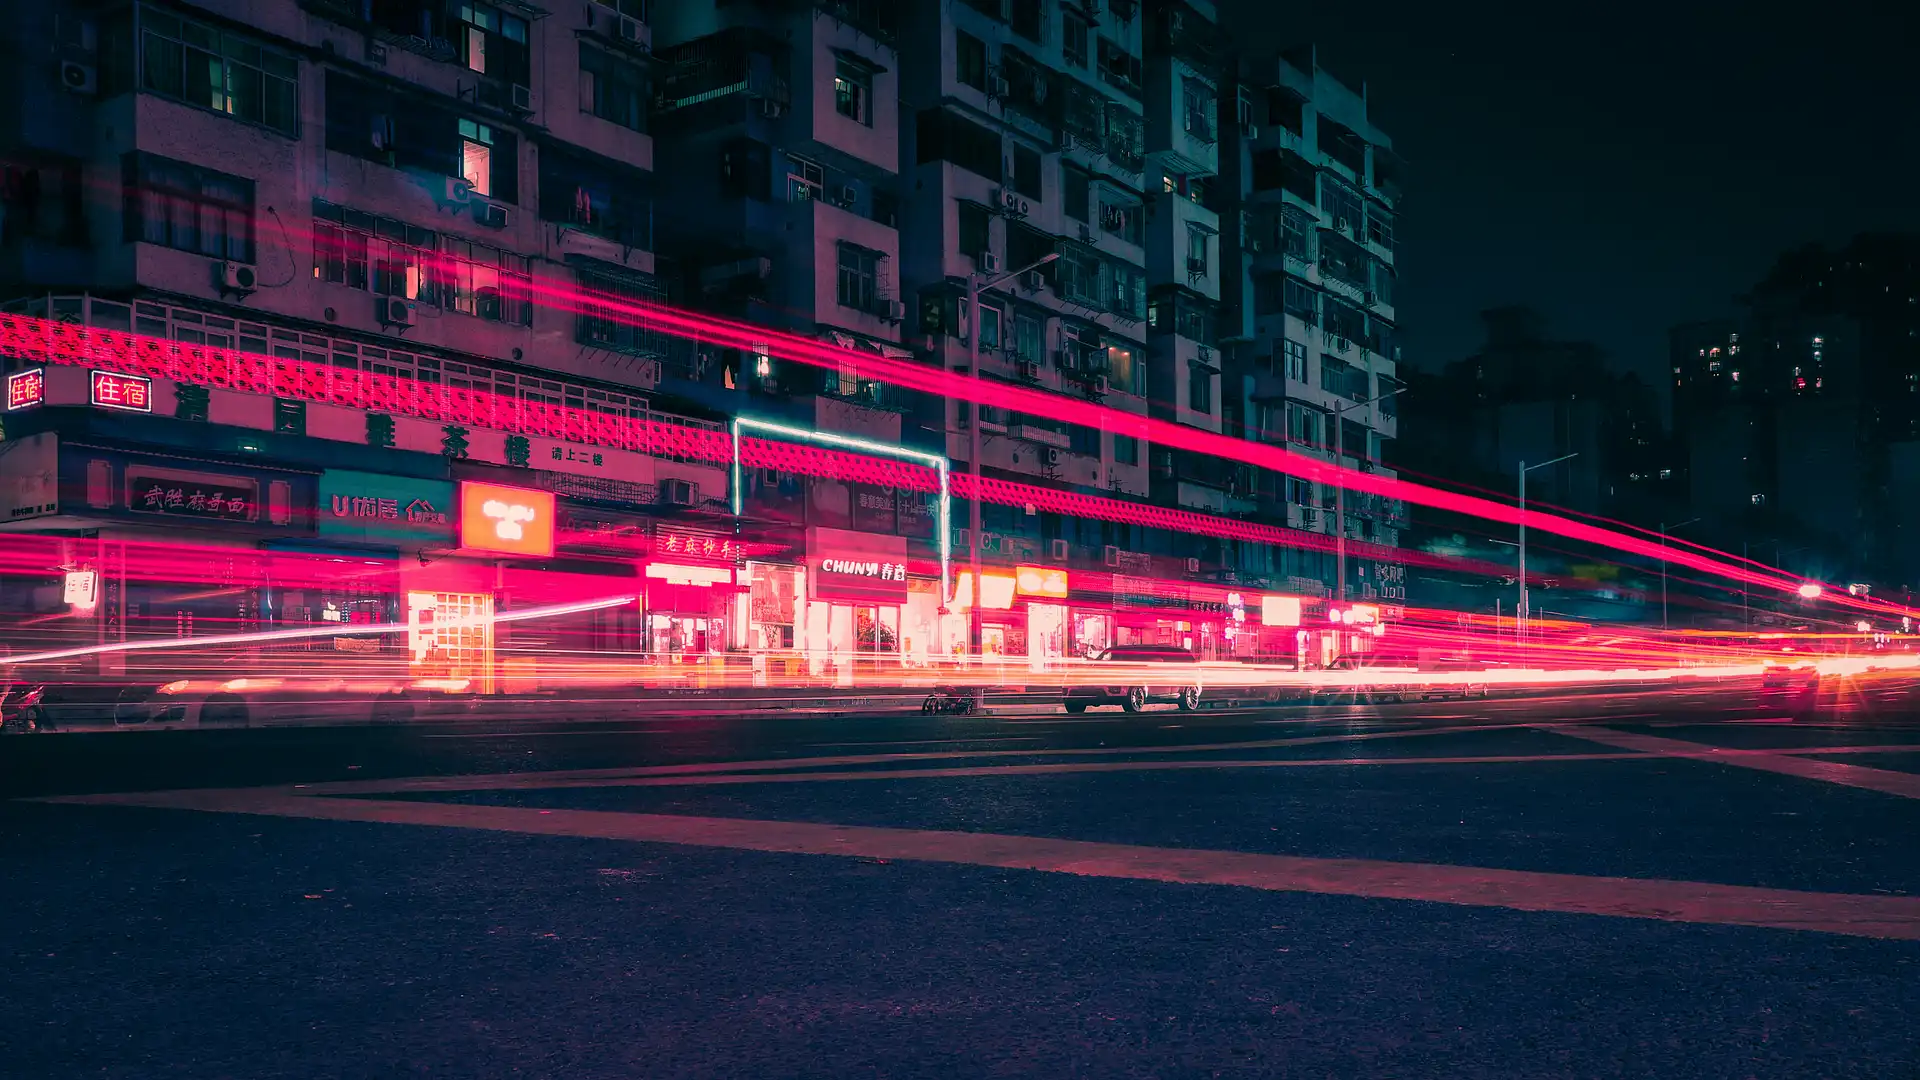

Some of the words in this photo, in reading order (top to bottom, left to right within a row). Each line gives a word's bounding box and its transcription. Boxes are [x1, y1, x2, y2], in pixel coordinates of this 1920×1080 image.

[12, 375, 38, 405] 住宿
[96, 376, 145, 405] 住宿
[552, 446, 603, 467] 请上二楼
[665, 534, 731, 558] 老麻抄手
